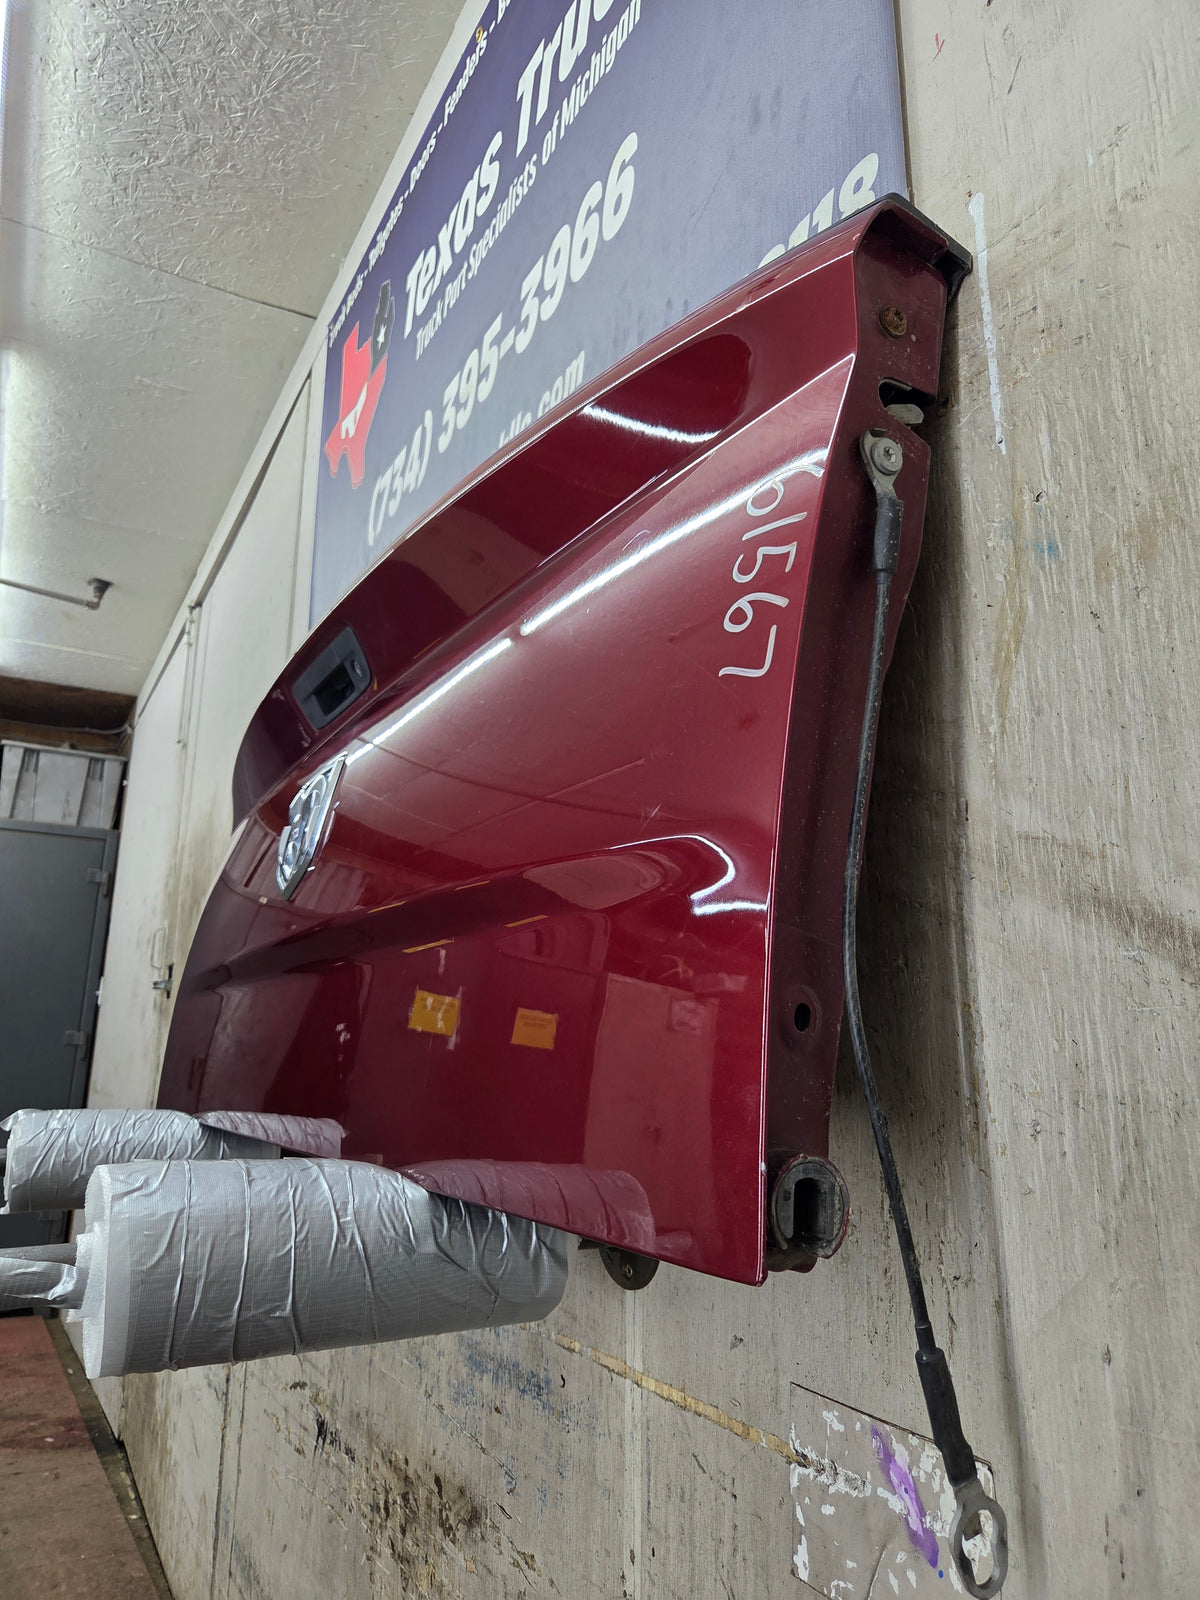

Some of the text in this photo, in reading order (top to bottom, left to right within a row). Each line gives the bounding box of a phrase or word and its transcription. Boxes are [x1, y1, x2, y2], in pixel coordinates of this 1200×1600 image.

[410, 130, 437, 193] Doors
[444, 30, 488, 127] Fenders
[415, 0, 642, 361] Truck Part Specialists of Michigan
[368, 132, 638, 546] (734) 395-3966
[404, 131, 503, 340] Texas
[719, 462, 826, 677] 61567
